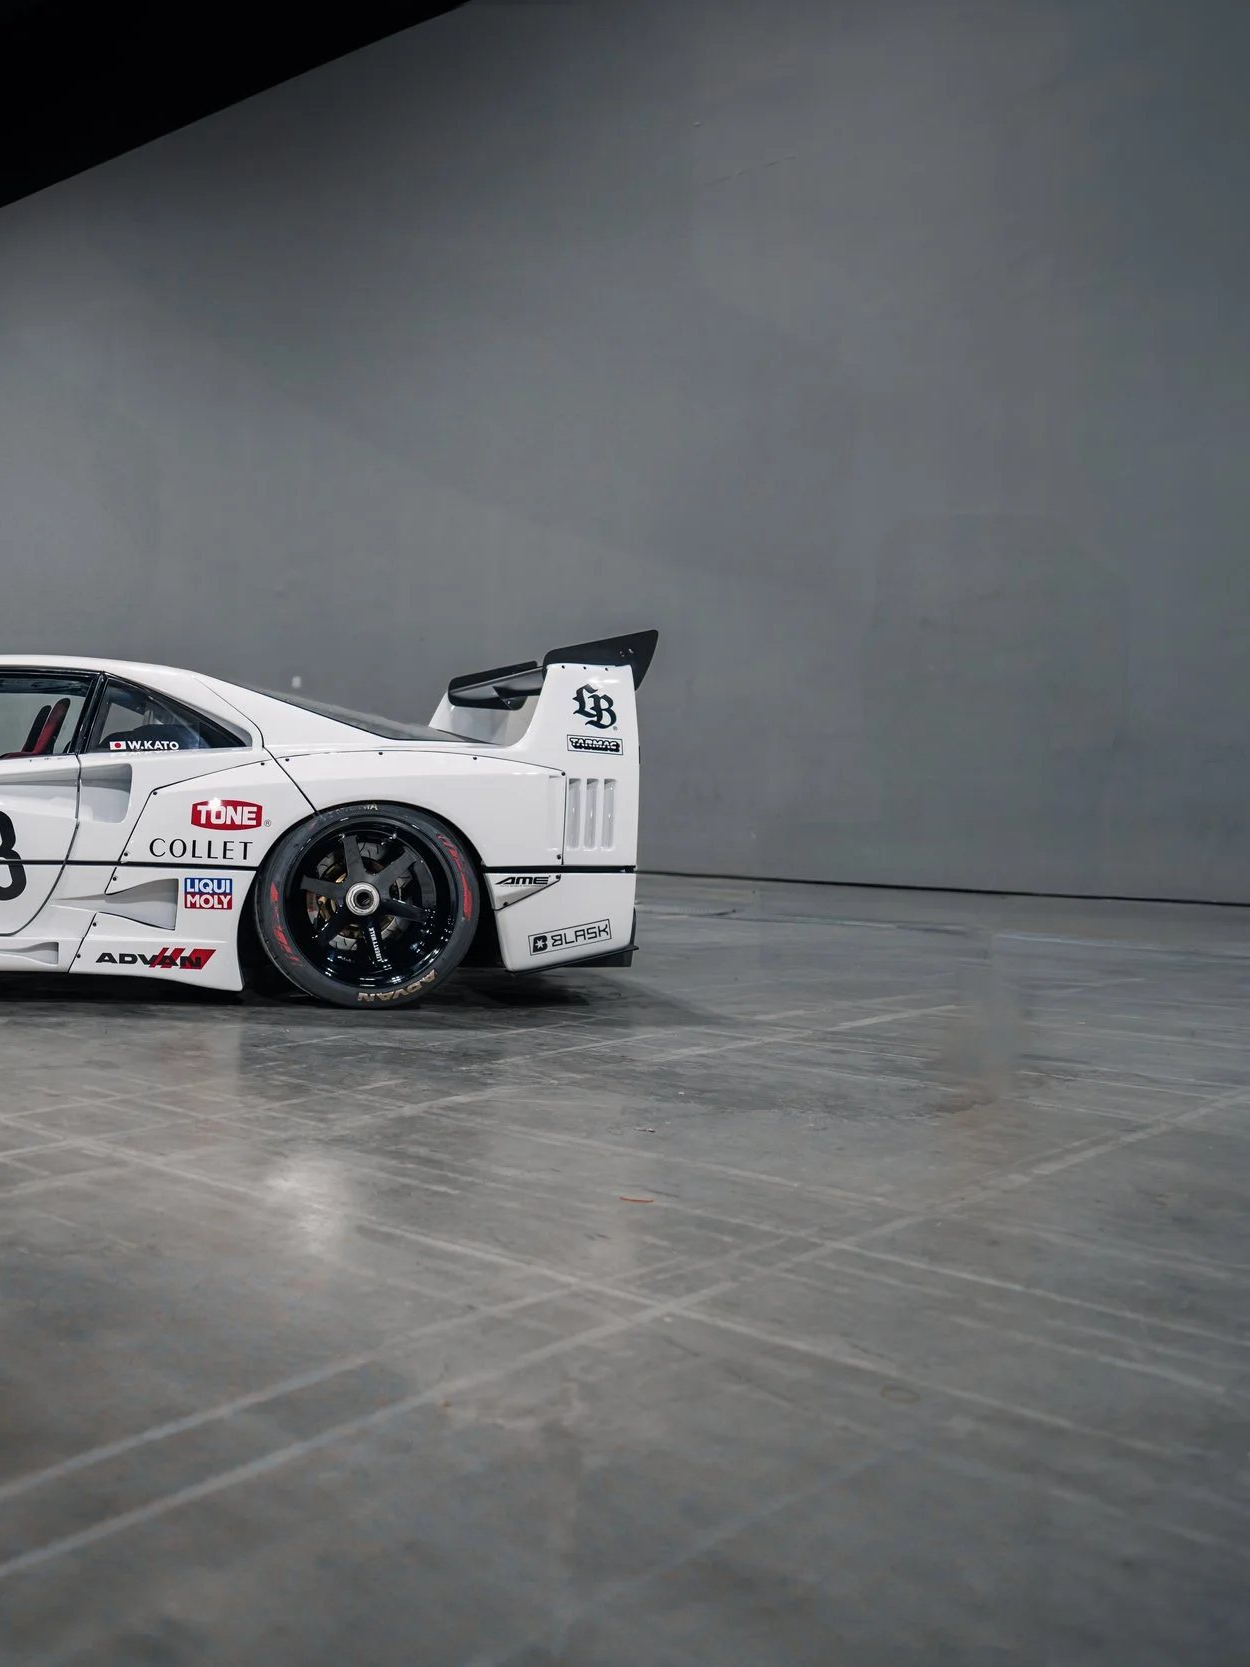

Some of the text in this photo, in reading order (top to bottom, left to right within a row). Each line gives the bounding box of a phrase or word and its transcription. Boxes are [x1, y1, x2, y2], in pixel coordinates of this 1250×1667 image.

[127, 740, 180, 750] W.KATO
[569, 737, 621, 753] TARMAC
[196, 805, 258, 826] TONE
[148, 837, 254, 861] COLLET
[185, 878, 231, 894] LIQUI
[494, 876, 550, 885] AME
[185, 894, 232, 909] MOLY
[551, 924, 610, 947] BLASK
[95, 952, 202, 967] ADVAN
[357, 969, 437, 1002] ADVAN
